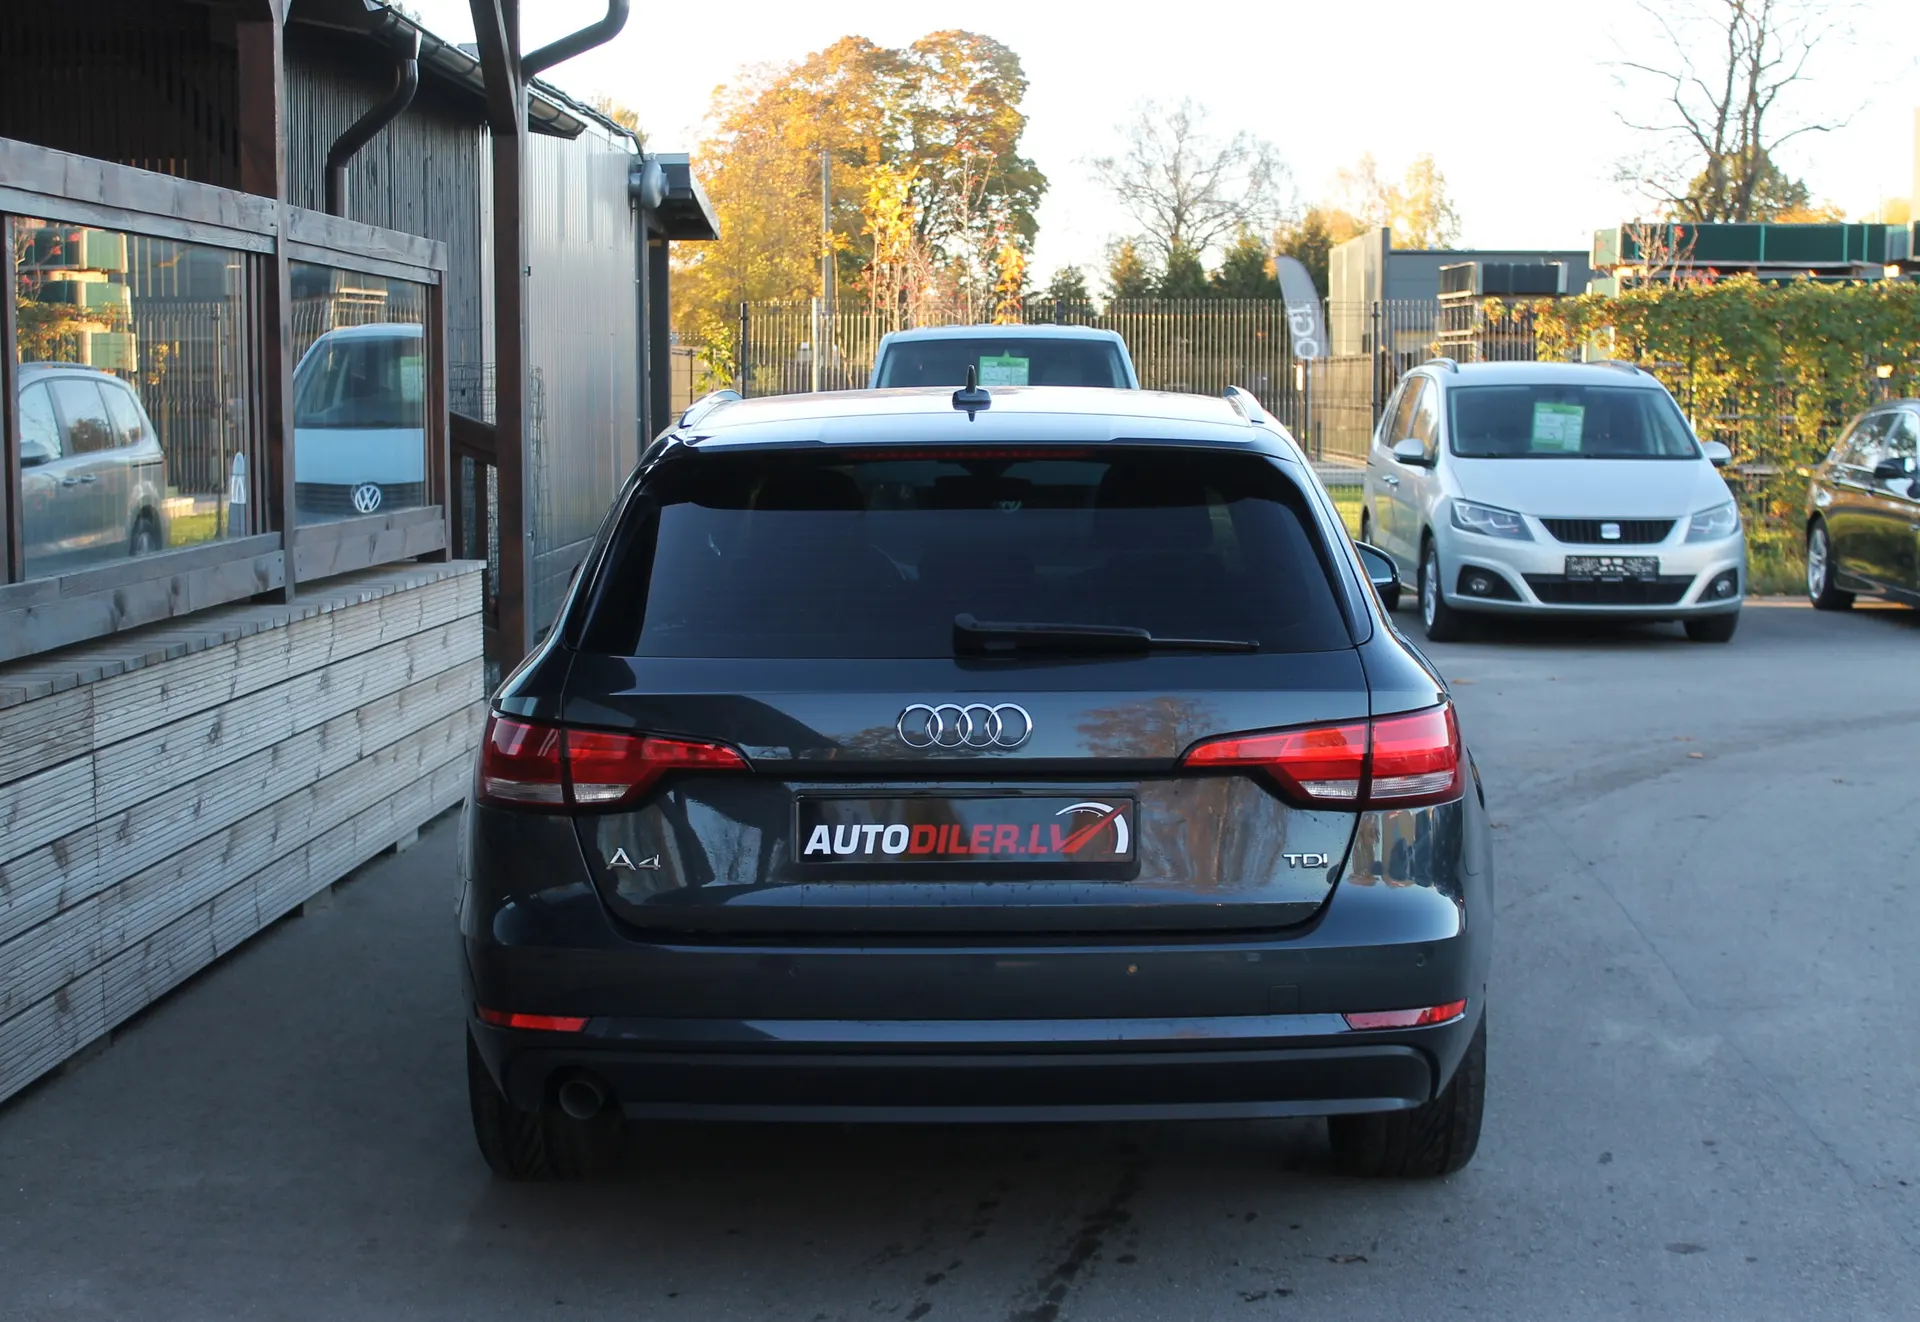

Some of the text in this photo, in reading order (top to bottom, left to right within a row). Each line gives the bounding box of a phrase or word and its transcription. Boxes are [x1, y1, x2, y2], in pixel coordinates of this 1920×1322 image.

[803, 823, 1093, 855] AUTODILER.LV
[605, 847, 661, 871] A4
[1282, 853, 1329, 868] TDI
